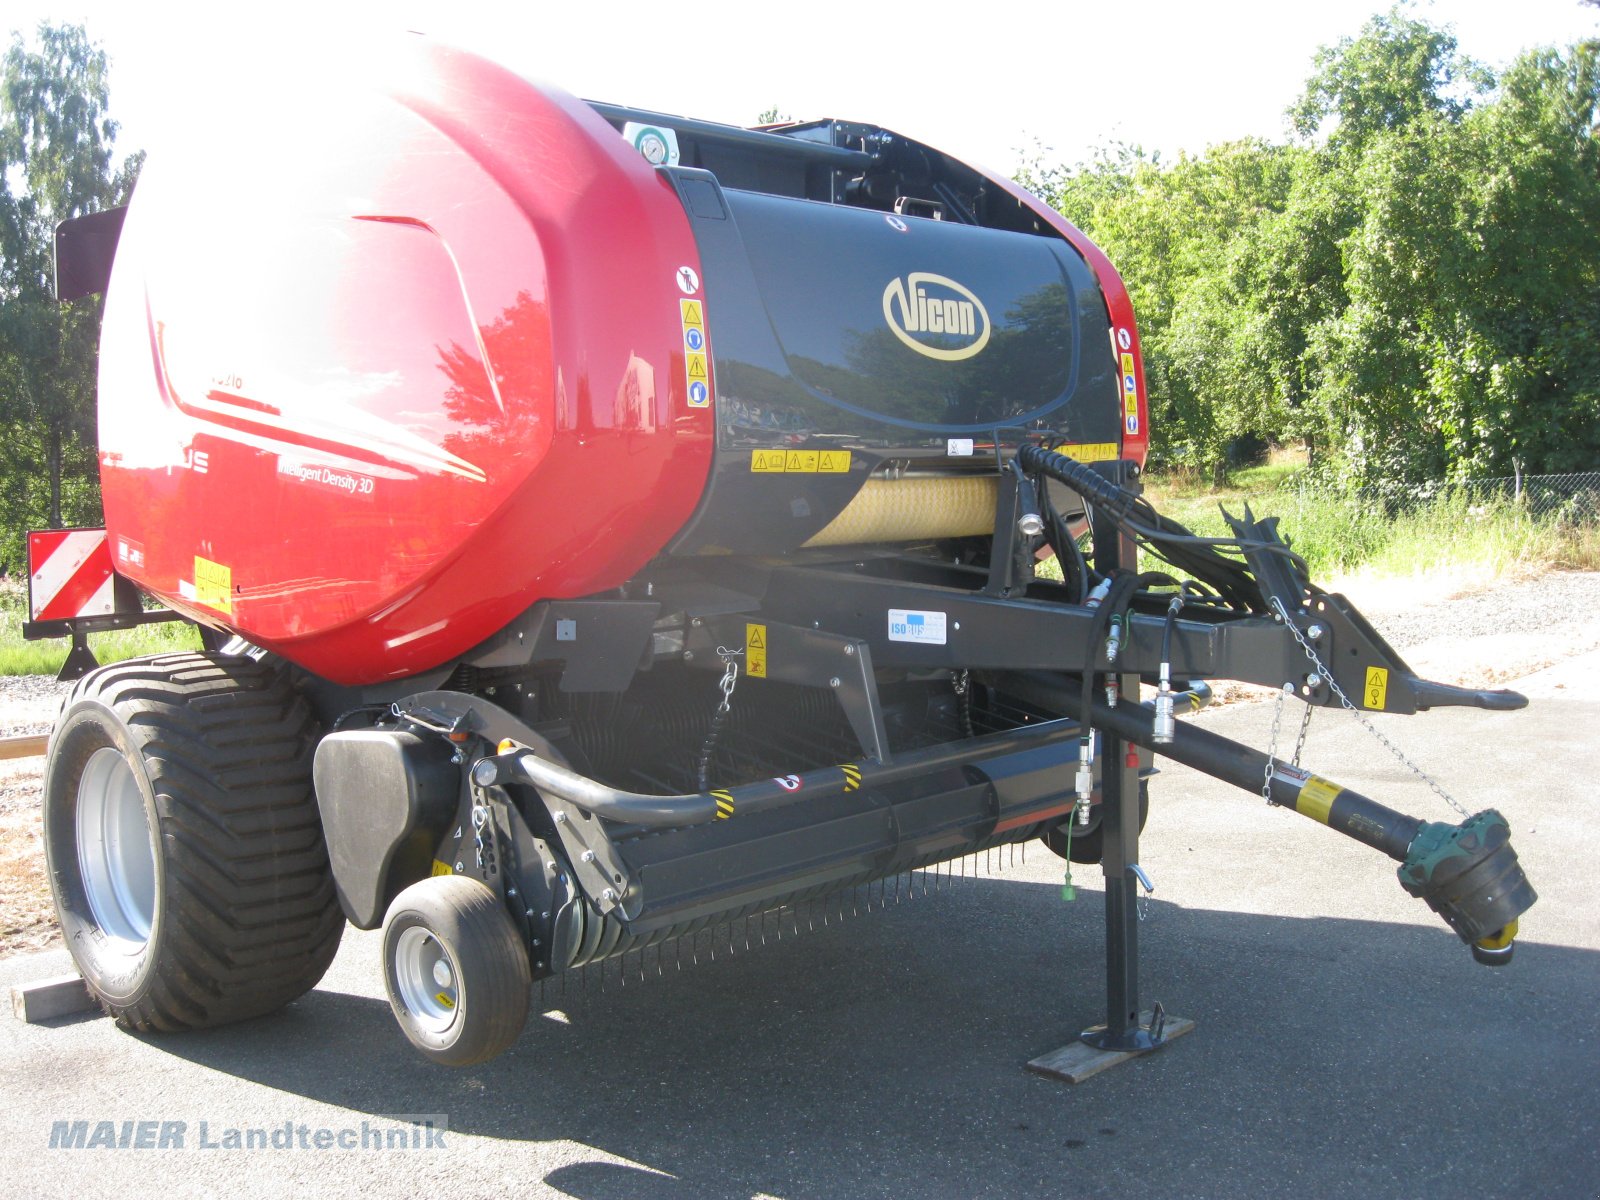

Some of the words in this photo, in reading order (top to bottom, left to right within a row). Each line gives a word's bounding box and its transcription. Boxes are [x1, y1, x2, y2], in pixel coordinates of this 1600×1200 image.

[893, 273, 978, 338] Vicon
[322, 468, 358, 493] Density
[358, 477, 374, 494] 3D
